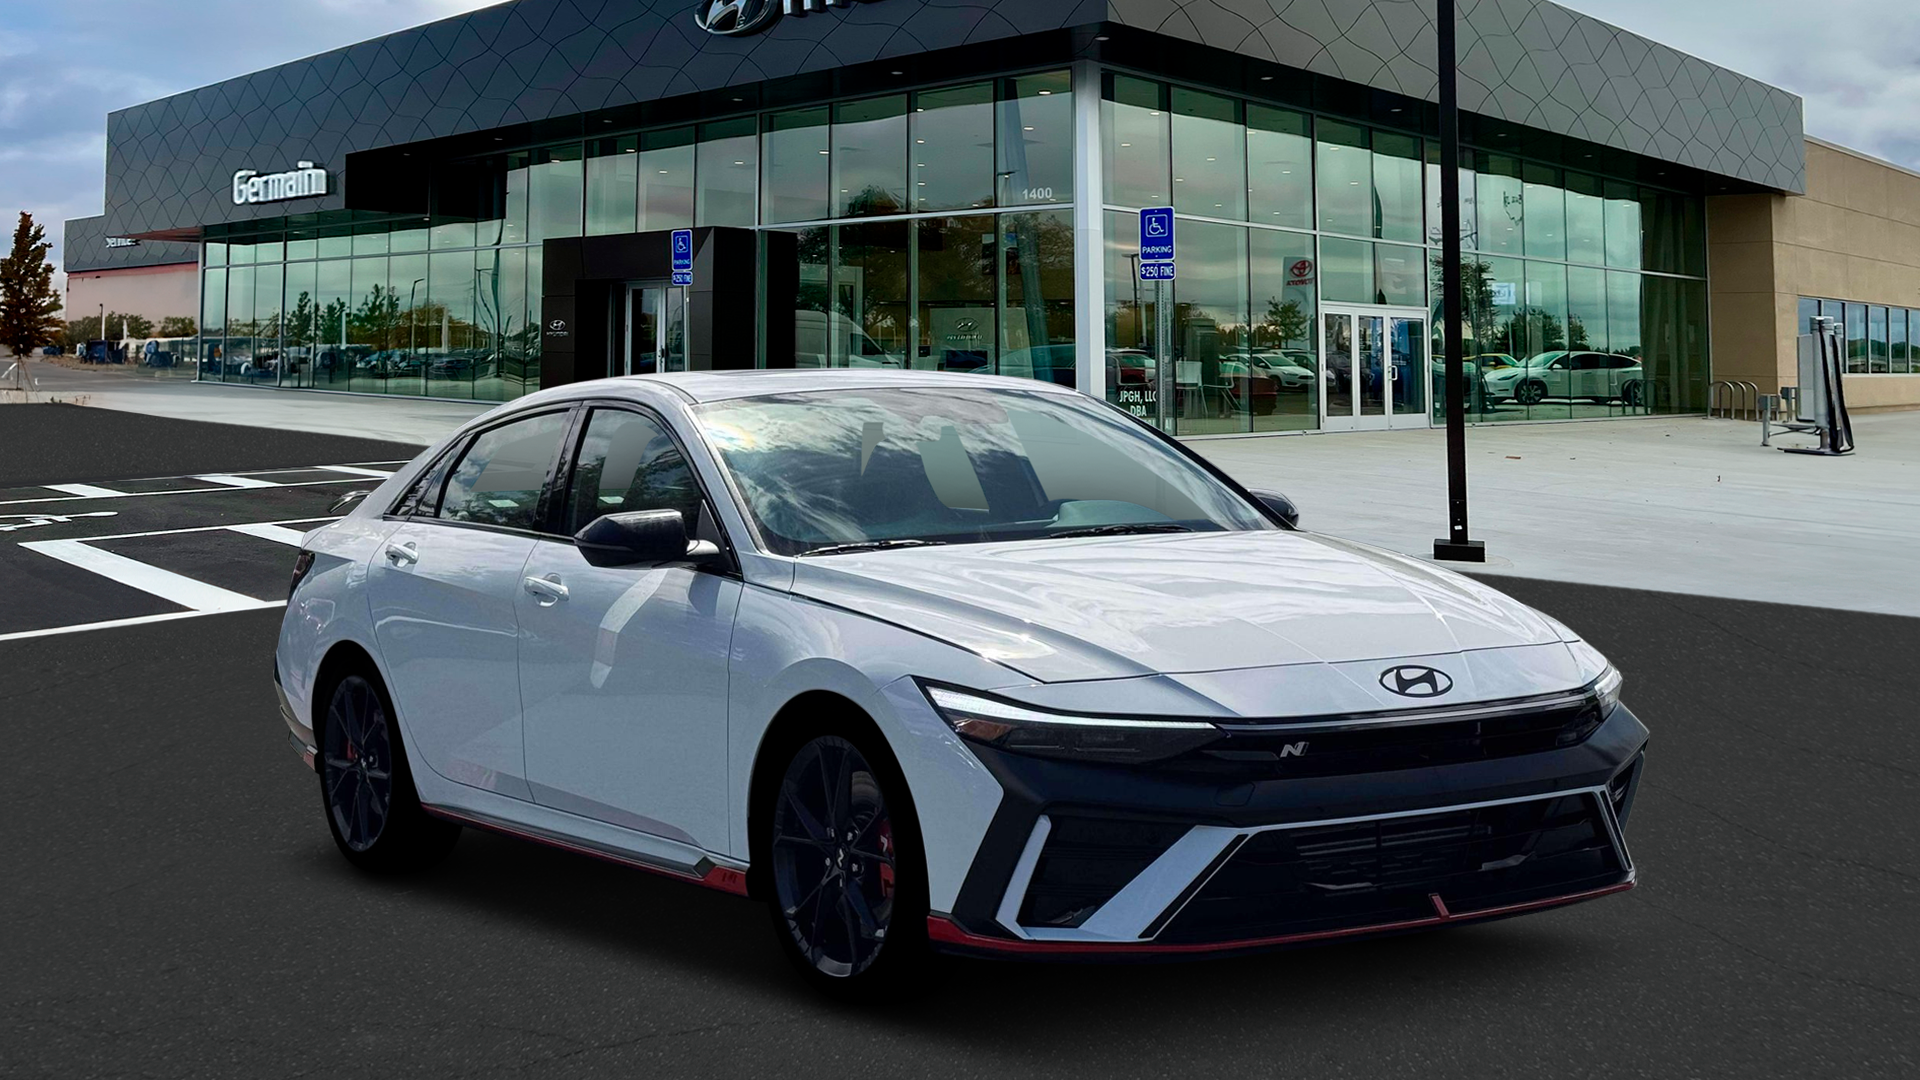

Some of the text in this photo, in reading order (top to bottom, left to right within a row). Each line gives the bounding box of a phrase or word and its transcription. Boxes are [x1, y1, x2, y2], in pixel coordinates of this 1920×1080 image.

[233, 161, 327, 205] Germain
[1022, 187, 1052, 200] 1400
[1142, 246, 1172, 254] PARKING
[1141, 266, 1174, 277] $250 FINE
[1119, 391, 1143, 404] JPGH,
[1130, 405, 1147, 416] DBA
